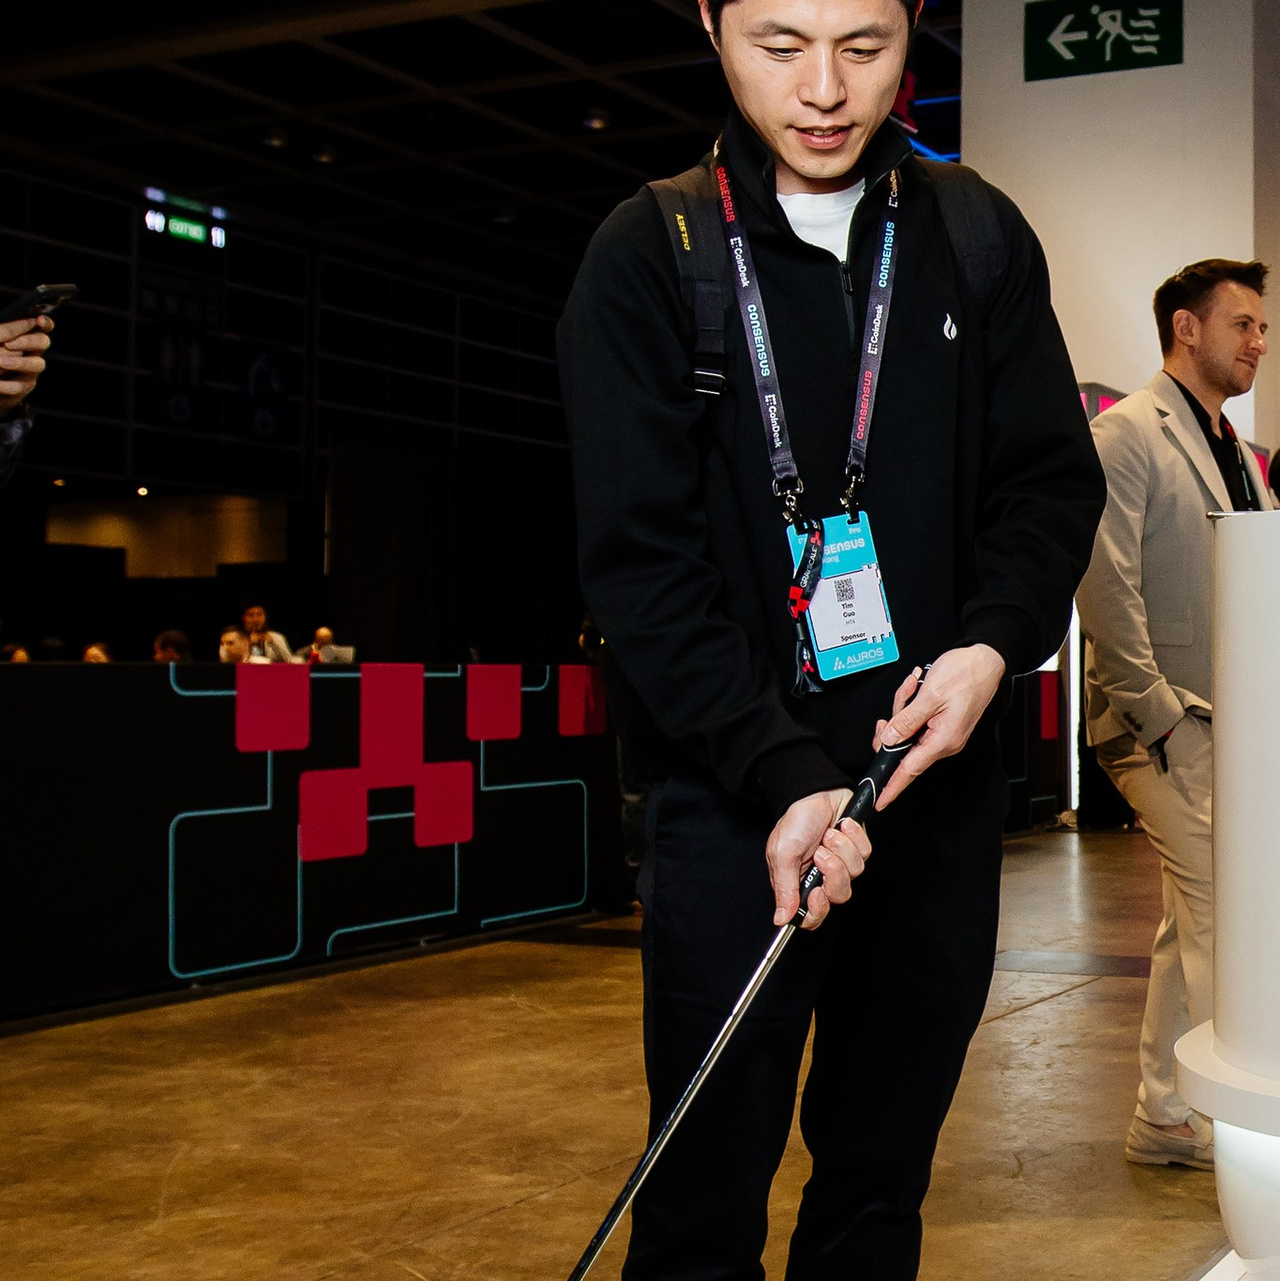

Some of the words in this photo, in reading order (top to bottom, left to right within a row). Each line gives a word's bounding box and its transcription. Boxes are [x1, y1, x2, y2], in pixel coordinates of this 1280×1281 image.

[890, 169, 898, 198] CoinDe
[675, 213, 691, 251] DELSEY
[734, 247, 750, 288] CoinDesk
[870, 304, 884, 344] CoinDesk
[768, 405, 782, 448] CoinDesk
[823, 537, 866, 555] SENSUS
[800, 545, 818, 588] GRAYSCALE
[841, 601, 854, 610] Tim
[840, 631, 867, 643] Sponsor
[846, 647, 884, 665] AUROS
[804, 865, 819, 888] NLOP
